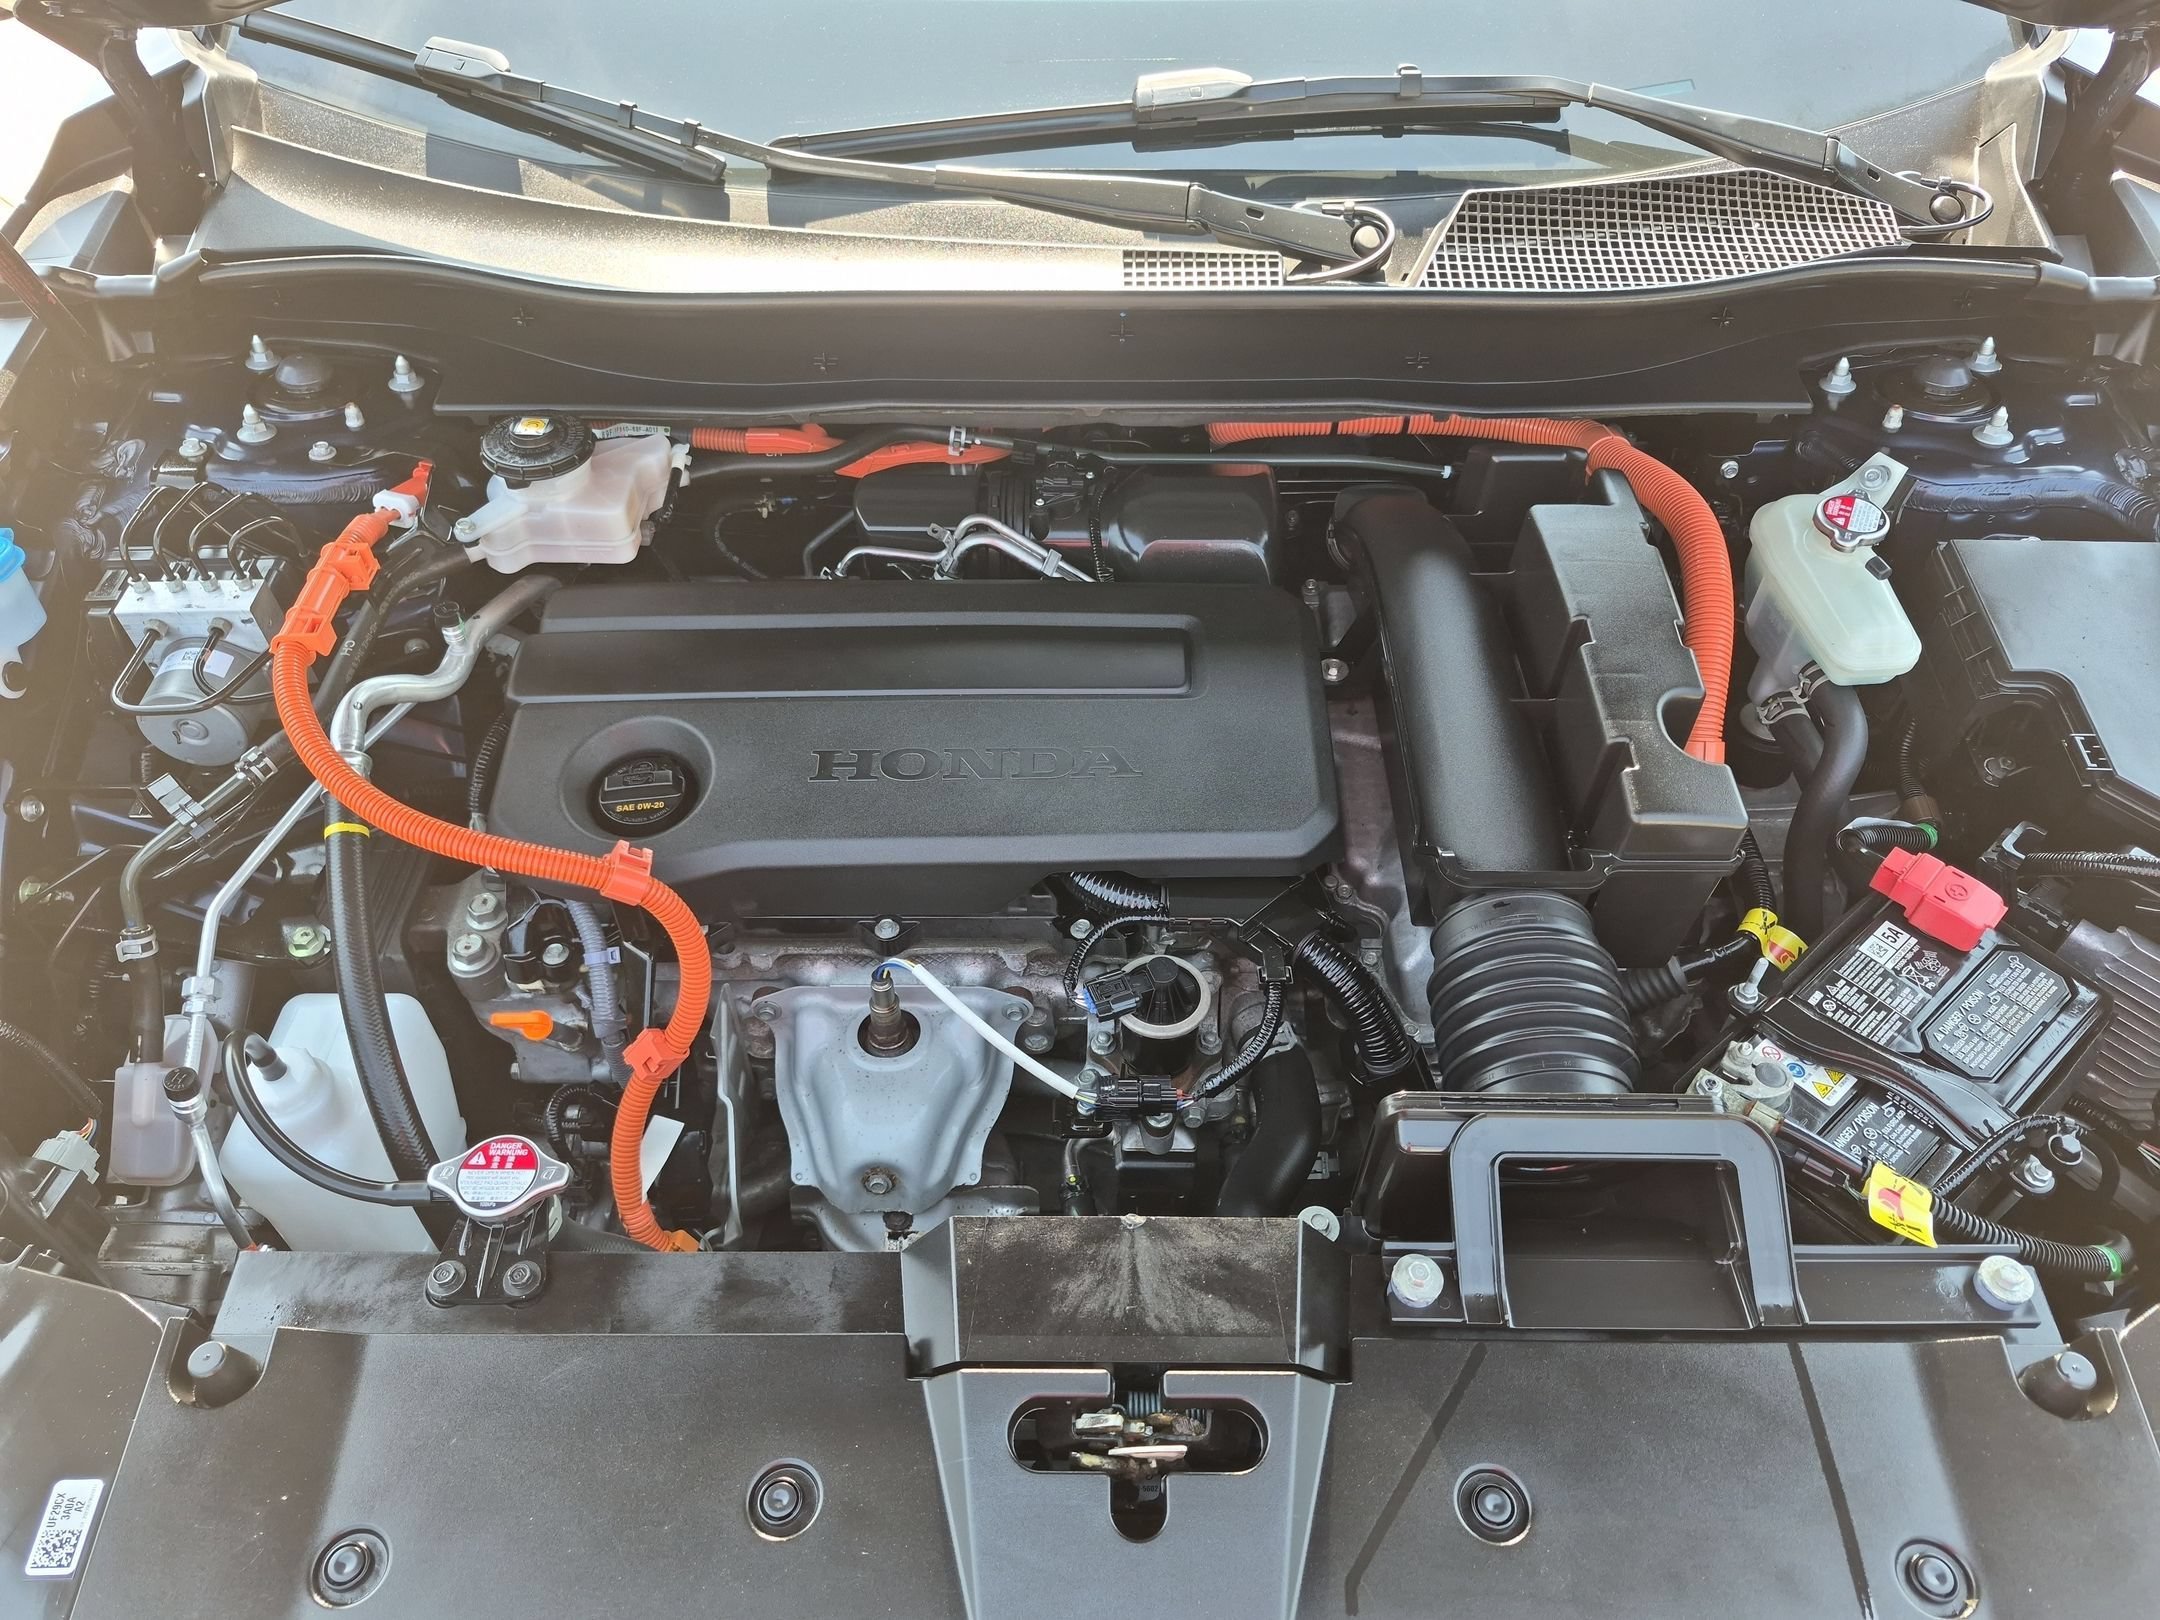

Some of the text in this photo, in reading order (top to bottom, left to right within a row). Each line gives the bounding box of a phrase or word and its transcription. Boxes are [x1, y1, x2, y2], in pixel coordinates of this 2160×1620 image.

[807, 745, 1144, 783] HONDA
[615, 801, 665, 812] SAE 0W-20
[1881, 927, 1903, 944] 5A
[1942, 1010, 1963, 1035] DANGER
[1962, 989, 1985, 1012] POISON
[1833, 1126, 1857, 1148] ANGER
[1854, 1101, 1880, 1128] POISON
[46, 1492, 67, 1528] UF29CX
[74, 1500, 86, 1513] A2
